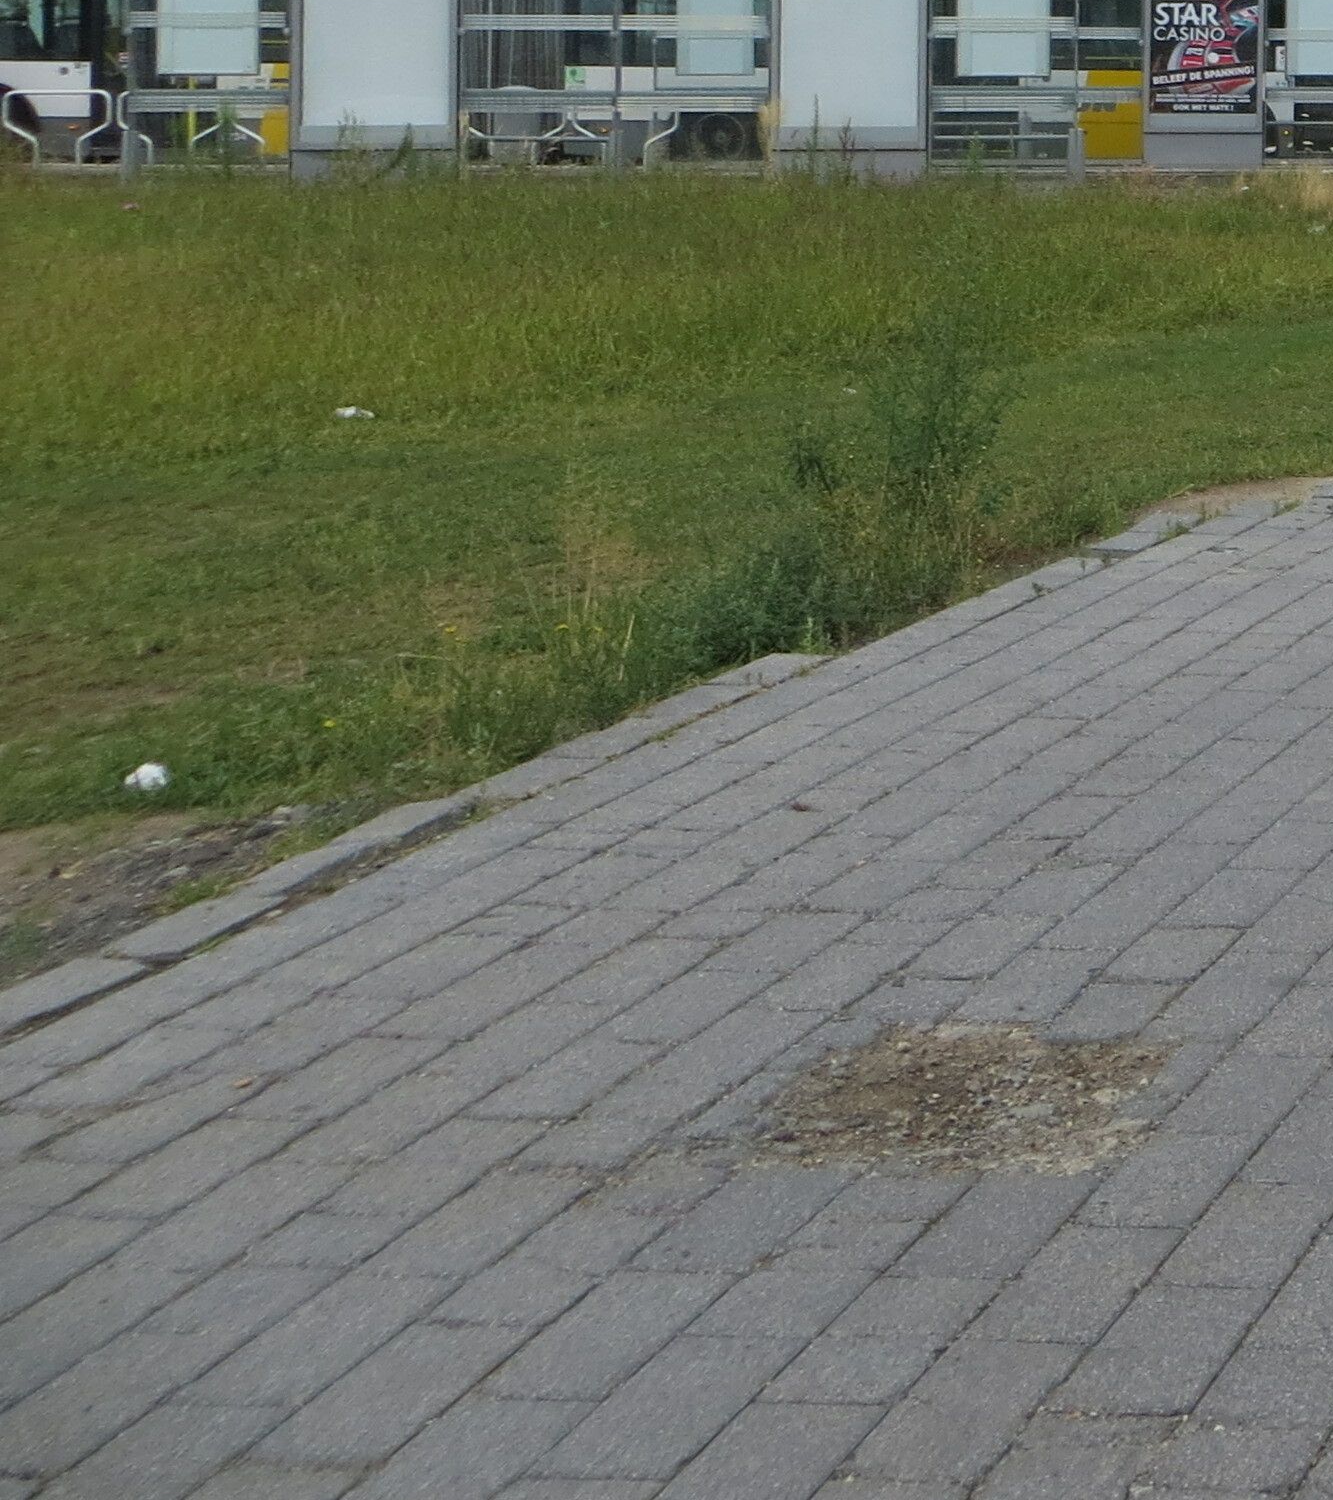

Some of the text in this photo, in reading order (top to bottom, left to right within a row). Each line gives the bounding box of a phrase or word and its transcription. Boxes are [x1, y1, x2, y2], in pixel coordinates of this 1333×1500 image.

[1153, 2, 1220, 26] STAR
[1153, 26, 1226, 41] CASINO
[1152, 66, 1255, 85] BELEEF DE SPANNING!
